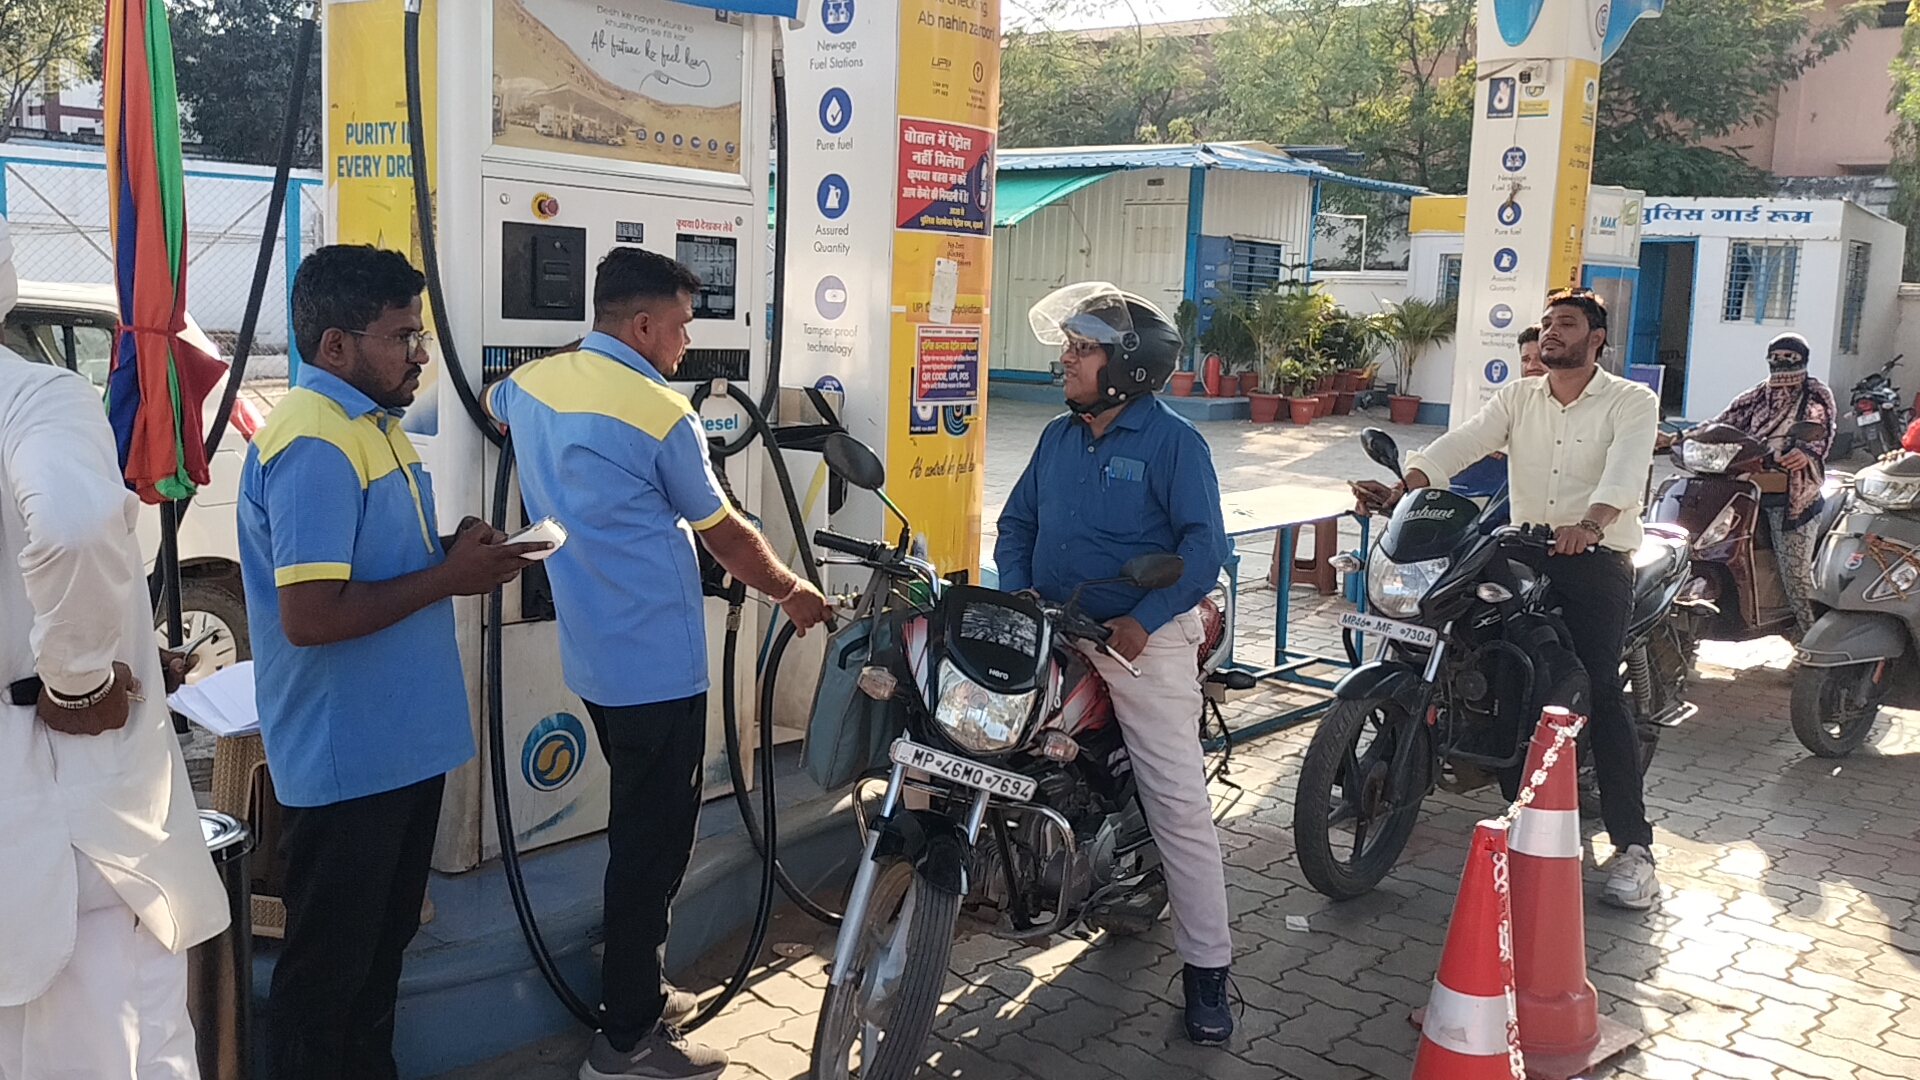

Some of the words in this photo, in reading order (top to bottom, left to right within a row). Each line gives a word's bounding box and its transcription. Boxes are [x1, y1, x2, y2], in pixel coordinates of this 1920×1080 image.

[597, 5, 620, 17] Desh
[622, 11, 632, 20] ke
[634, 14, 655, 26] naye
[657, 18, 682, 31] future
[684, 24, 694, 33] ko
[917, 10, 935, 27] Ab
[938, 15, 967, 33] nahin
[591, 30, 607, 53] Ab
[611, 35, 641, 58] future
[817, 39, 857, 53] New-age
[810, 57, 828, 70] Fuel
[829, 56, 864, 69] Stations
[346, 122, 397, 145] PURITY
[904, 127, 936, 146] बोतल
[938, 130, 947, 147] में
[948, 132, 972, 151] पेट्रोल
[816, 138, 836, 150] Pure
[837, 136, 853, 150] fuel
[337, 155, 381, 178] EVERY
[386, 155, 414, 178] DRO
[912, 149, 933, 166] नहीं
[935, 150, 965, 169] मिलेगा
[1600, 216, 1617, 228] MAK
[1641, 203, 1704, 224] पुलिस
[1711, 205, 1762, 223] गार्ड
[1767, 209, 1813, 224] रूम
[815, 223, 849, 236] Assured
[813, 241, 850, 257] Quantity
[806, 340, 853, 357] technology
[701, 413, 738, 431] iesel
[1405, 628, 1432, 643] 7304
[989, 667, 1009, 680] Hero
[911, 749, 935, 767] MP
[989, 774, 1032, 799] 7694
